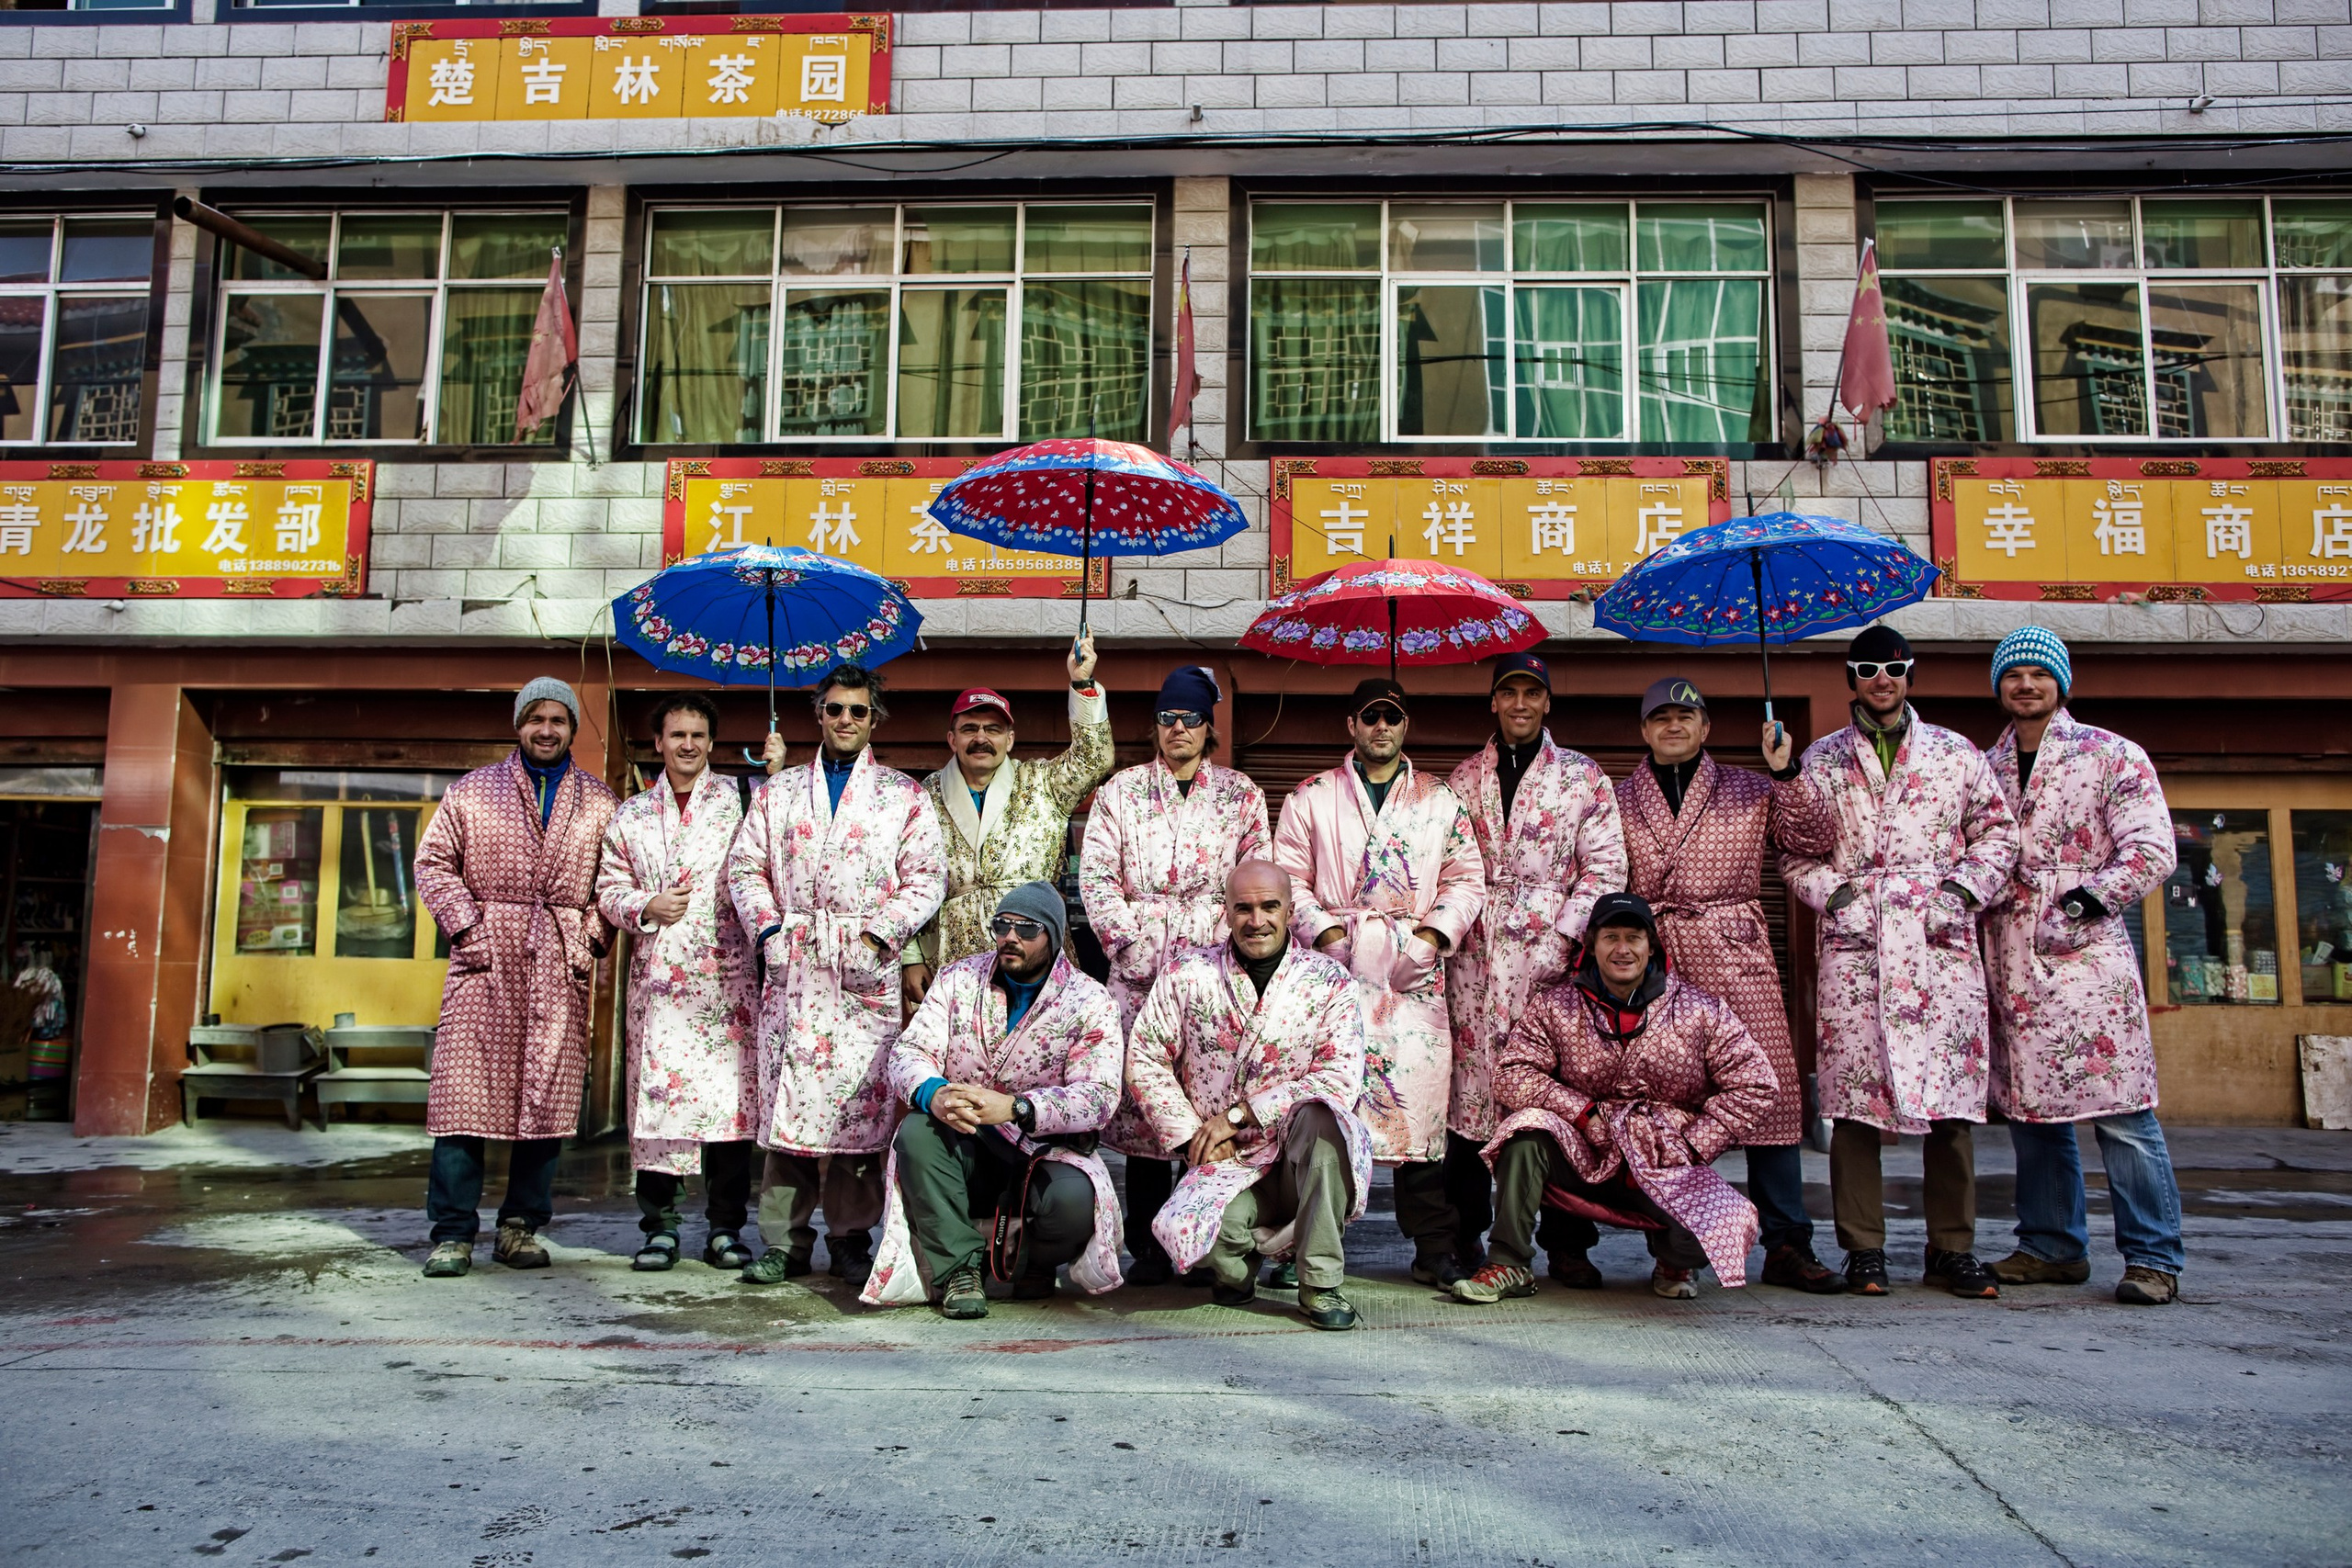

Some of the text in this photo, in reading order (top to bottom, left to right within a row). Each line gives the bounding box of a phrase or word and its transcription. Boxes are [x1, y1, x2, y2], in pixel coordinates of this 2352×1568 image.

[428, 53, 847, 107] 楚吉林茶园
[0, 502, 322, 555] 青龙批发部
[706, 501, 1036, 555] 江林茶
[1320, 501, 1682, 556] 吉祥商店
[1983, 498, 2352, 559] 幸福商店
[995, 1215, 1007, 1246] Canon
